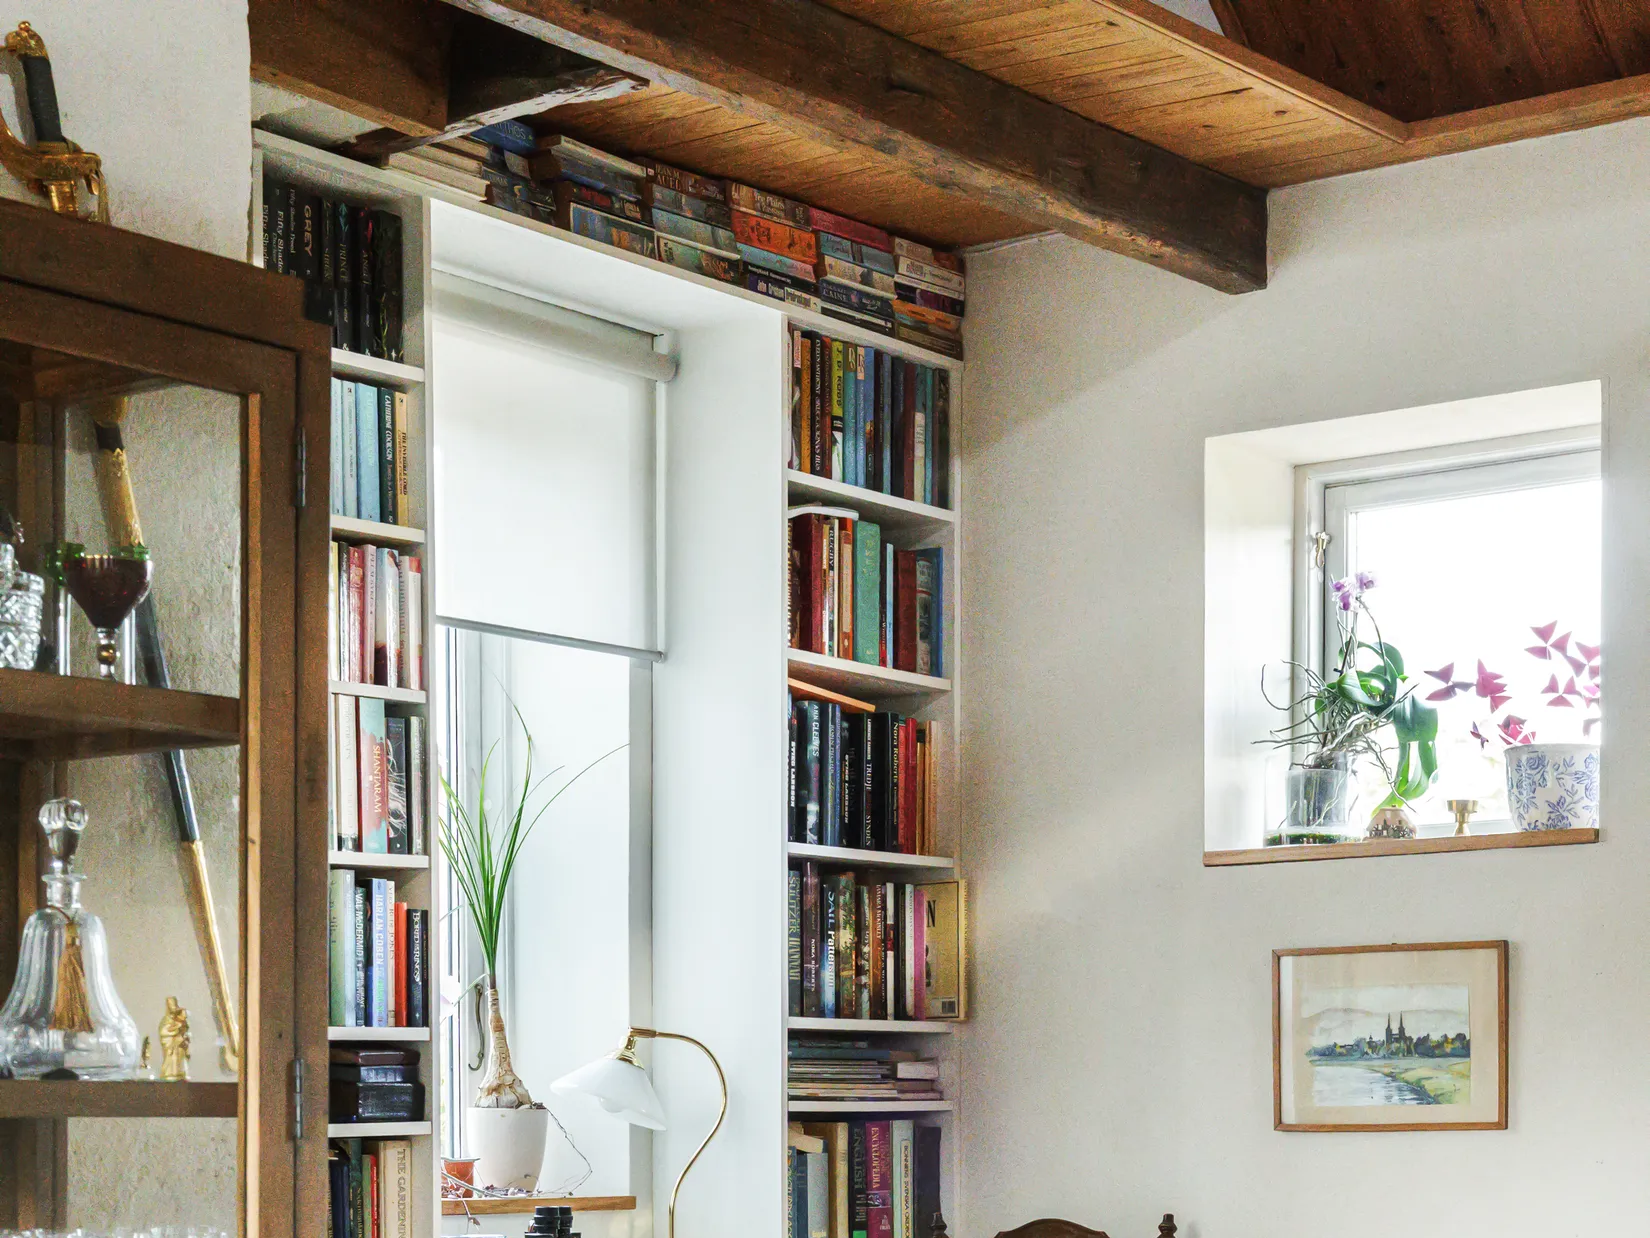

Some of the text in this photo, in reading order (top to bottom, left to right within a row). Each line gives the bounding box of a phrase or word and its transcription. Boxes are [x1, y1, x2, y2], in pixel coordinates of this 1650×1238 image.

[304, 204, 312, 257] GREY
[339, 243, 348, 281] PRINCE
[384, 431, 393, 461] COOKSON
[812, 721, 820, 757] CLEEVES
[372, 745, 382, 813] SHANTARAM
[863, 763, 873, 790] TREDJE
[355, 893, 363, 909] VAL
[375, 894, 384, 931] HARLAN
[789, 875, 797, 935] SULITZER
[375, 933, 384, 965] COBEN
[387, 930, 395, 961] JOKES
[827, 890, 836, 988] SAIL Patterson
[412, 950, 422, 983] RINGS
[789, 936, 801, 981] HANNAH
[397, 1148, 407, 1175] THE
[853, 1127, 865, 1189] ENGLISH
[871, 1127, 881, 1189] ENCYCLOPEDIA
